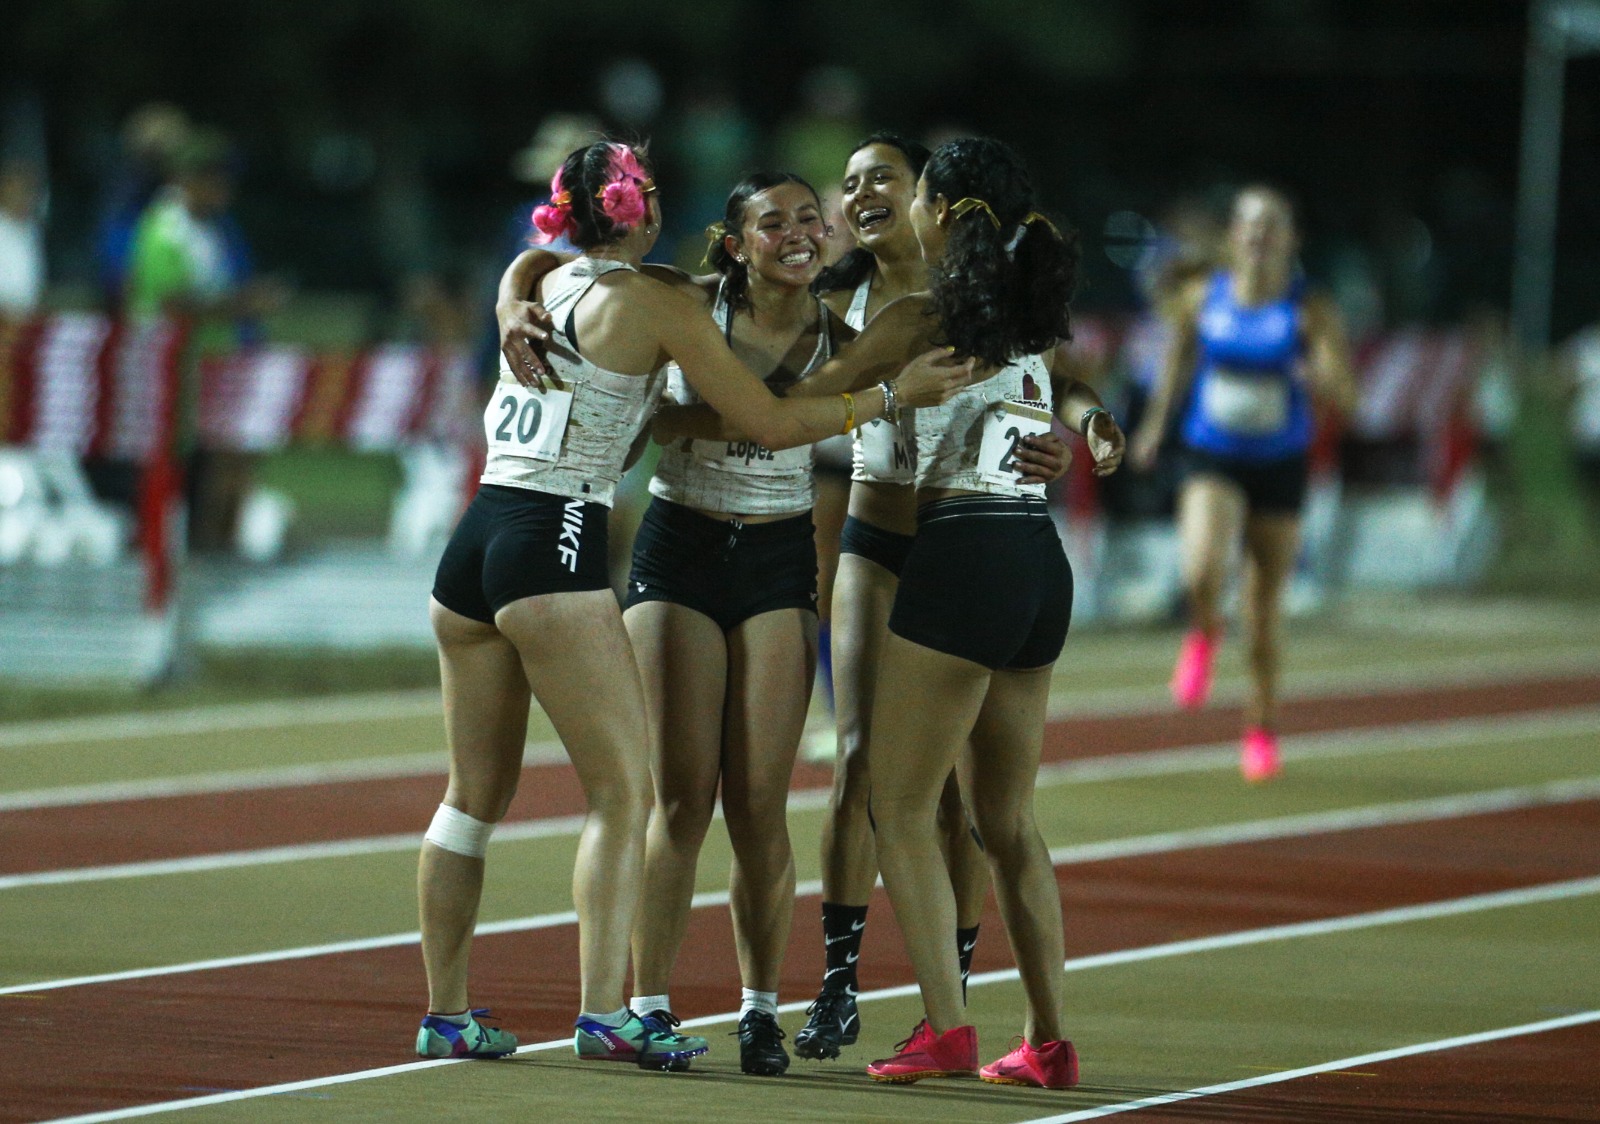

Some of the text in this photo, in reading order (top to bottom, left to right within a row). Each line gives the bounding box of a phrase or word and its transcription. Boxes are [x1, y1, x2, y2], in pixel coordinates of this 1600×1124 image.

[495, 395, 542, 444] 20
[726, 441, 775, 466] Lopez
[893, 441, 909, 470] M
[999, 426, 1037, 474] 2
